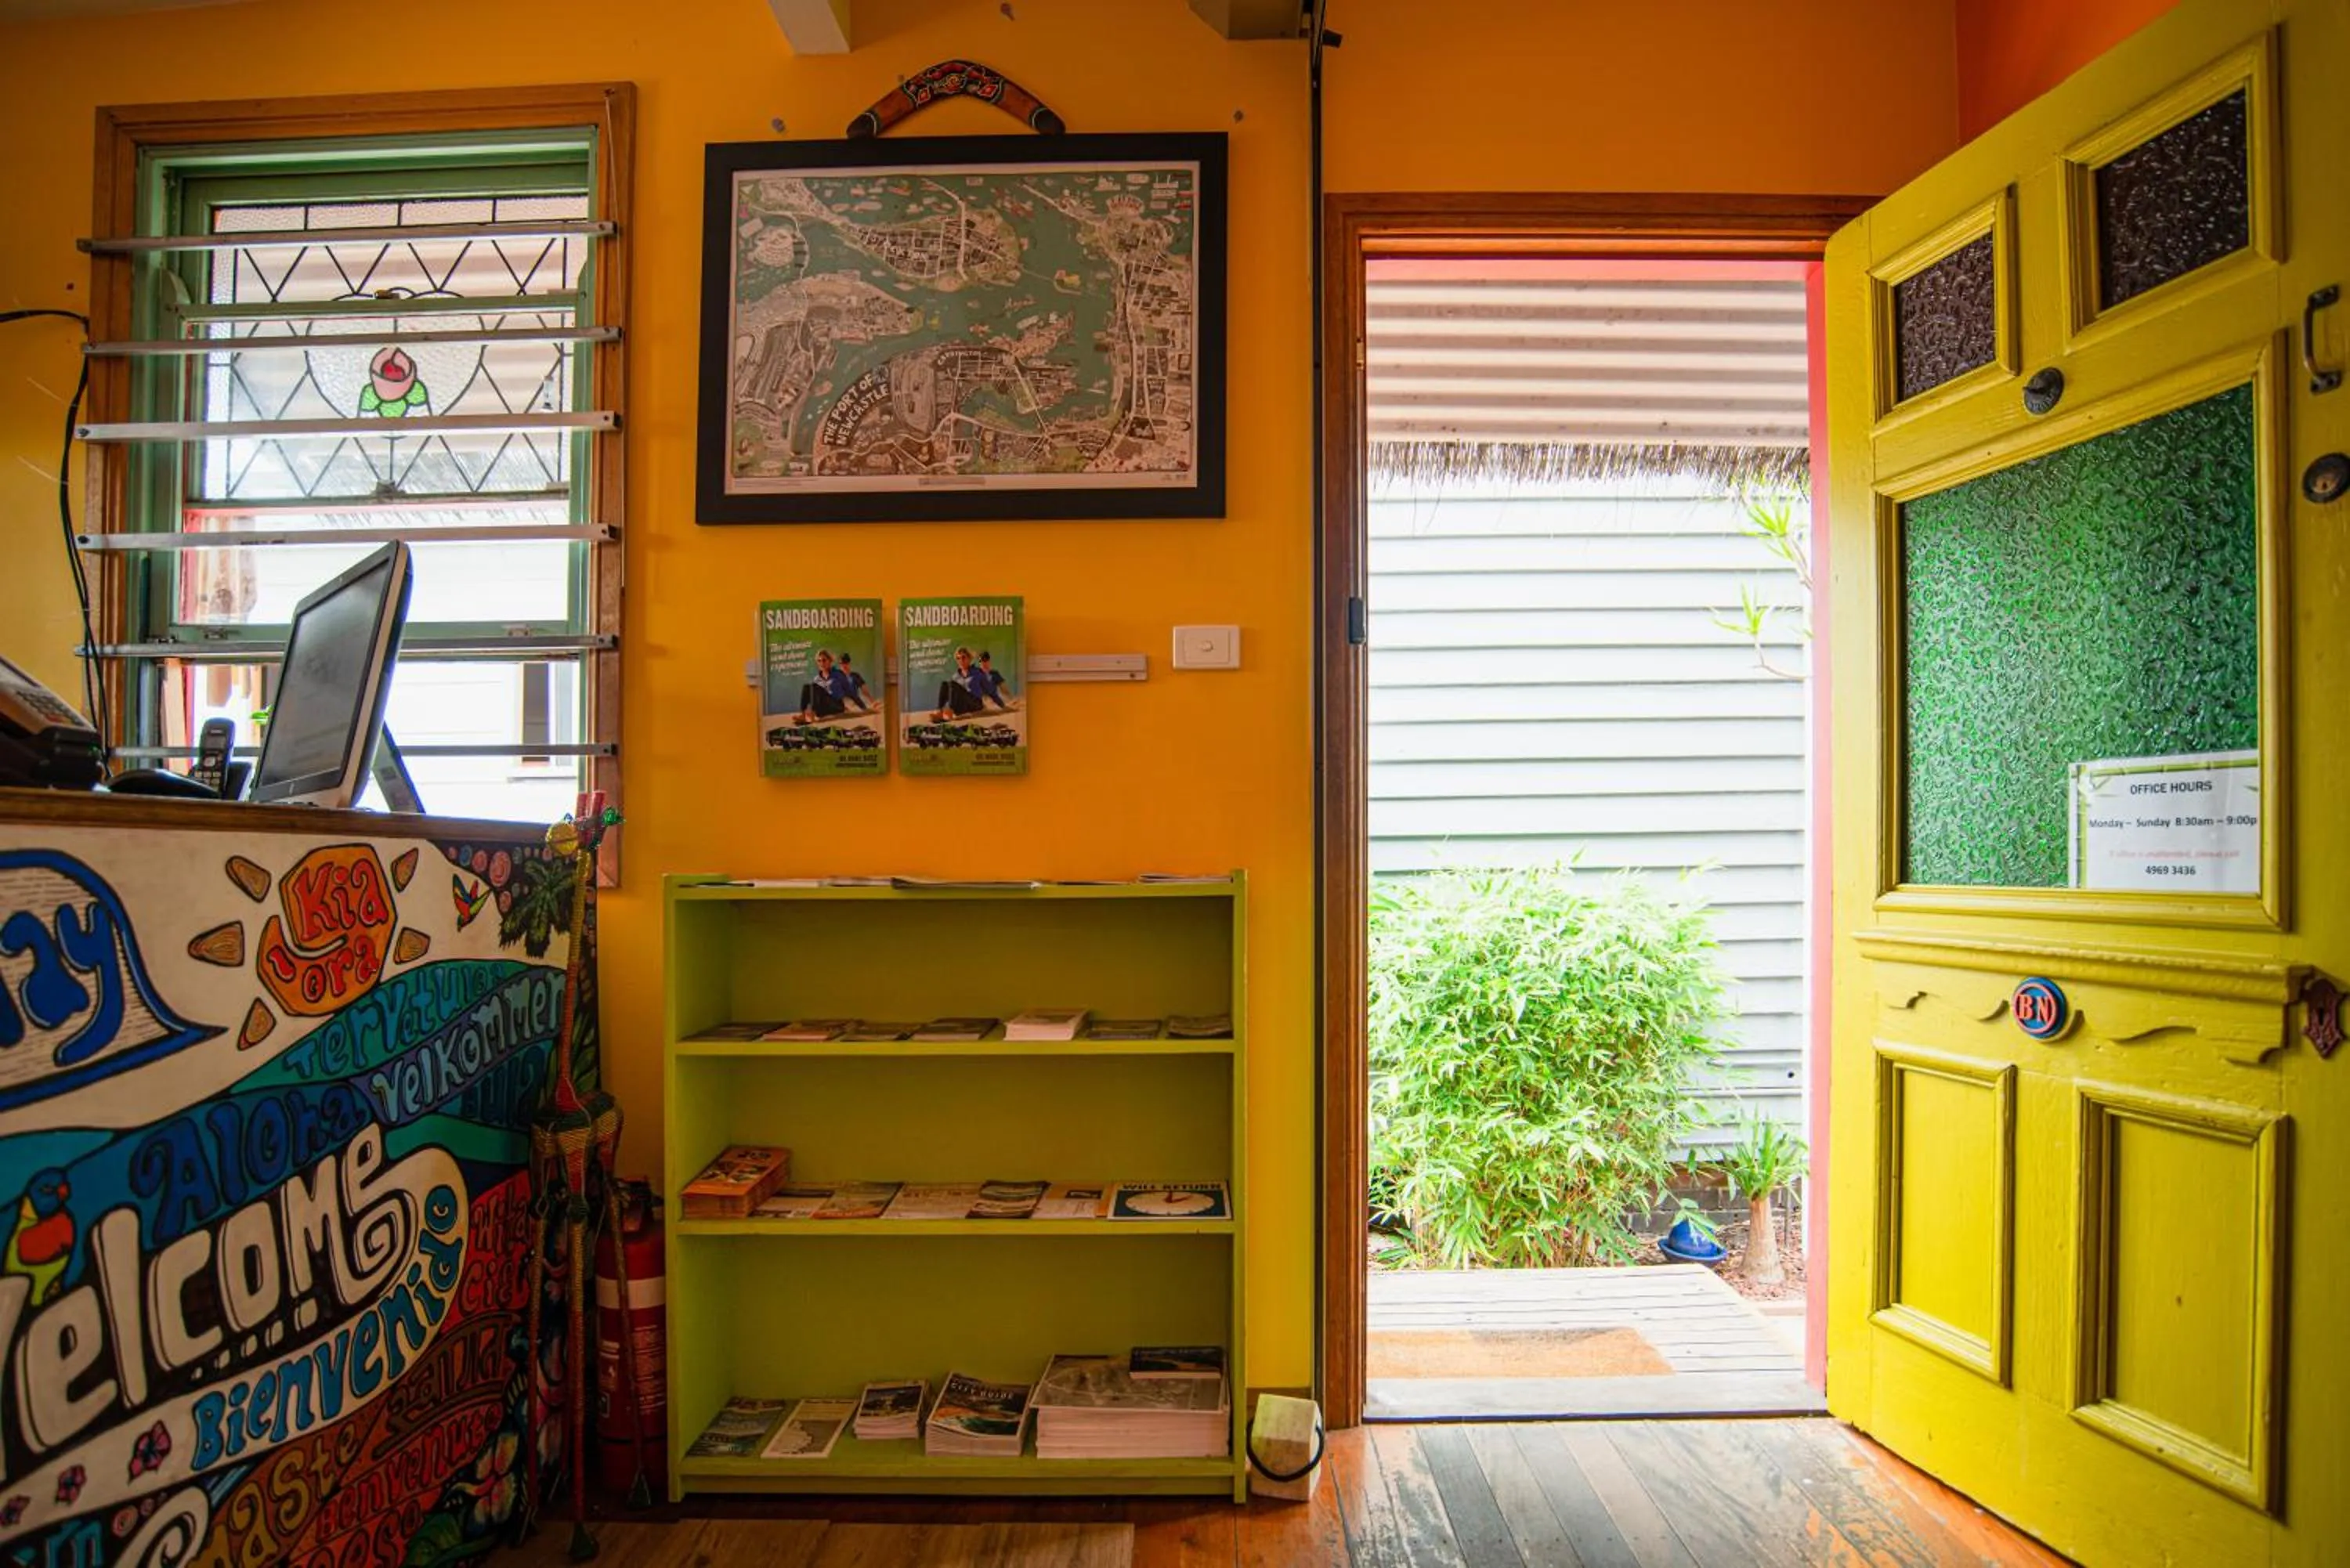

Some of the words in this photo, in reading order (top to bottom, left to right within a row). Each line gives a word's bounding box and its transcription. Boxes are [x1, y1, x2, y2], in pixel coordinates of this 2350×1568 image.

[824, 421, 839, 445] THE
[832, 385, 861, 419] PORT
[859, 373, 874, 390] OF
[836, 384, 890, 445] NEWCASTLE
[765, 608, 874, 629] SANDBOARDING
[905, 605, 1014, 627] SANDBOARDING
[2130, 783, 2167, 794] OFFICE
[2171, 781, 2212, 793] HOURS
[2090, 818, 2124, 829] Monday
[2137, 817, 2170, 828] Sunday
[2175, 816, 2213, 826] 8:30am
[2146, 865, 2169, 875] 4969
[292, 858, 389, 941] Kia
[2019, 993, 2051, 1022] BN
[190, 1184, 463, 1471] Bienvenido
